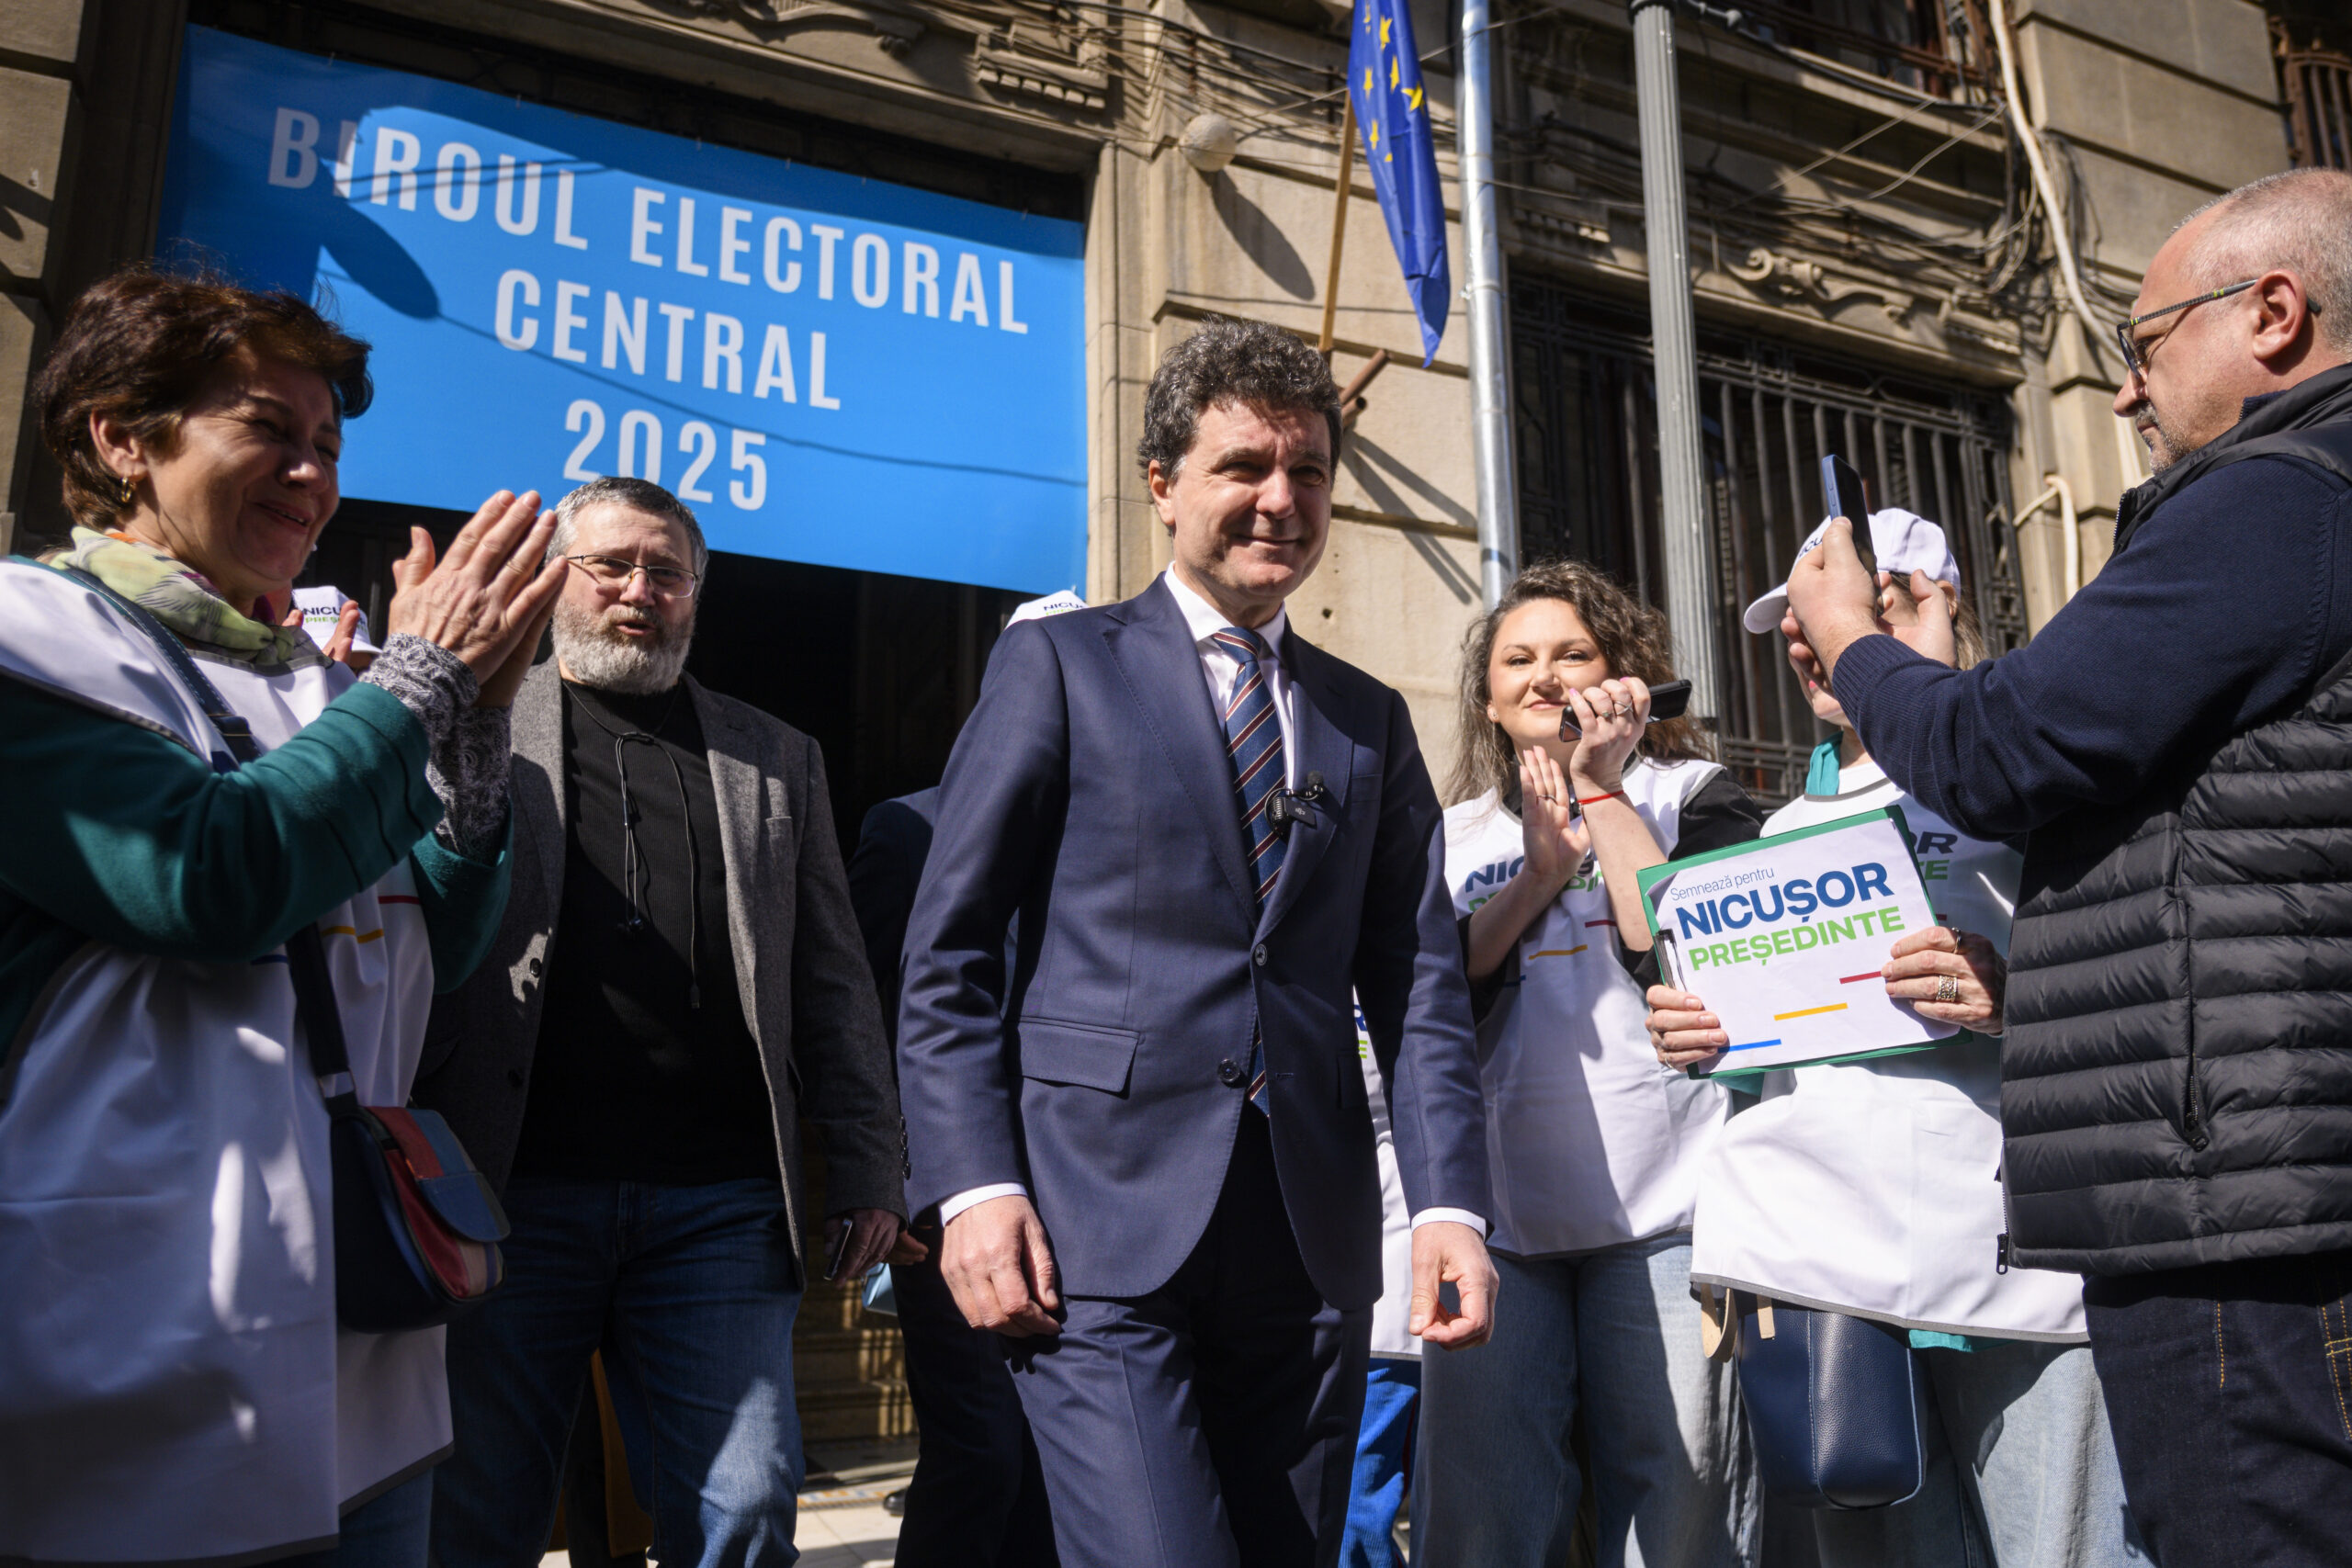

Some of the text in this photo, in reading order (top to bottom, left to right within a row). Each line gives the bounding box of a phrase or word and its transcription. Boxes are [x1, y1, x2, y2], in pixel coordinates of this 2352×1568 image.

[267, 106, 1029, 334] BIROUL ELECTORAL
[494, 269, 841, 411] CENTRAL
[563, 399, 768, 511] 2025
[1670, 867, 1774, 901] Semnează pentru
[1675, 862, 1894, 941] NICUȘOR
[1688, 906, 1905, 971] PREȘEDINTE
